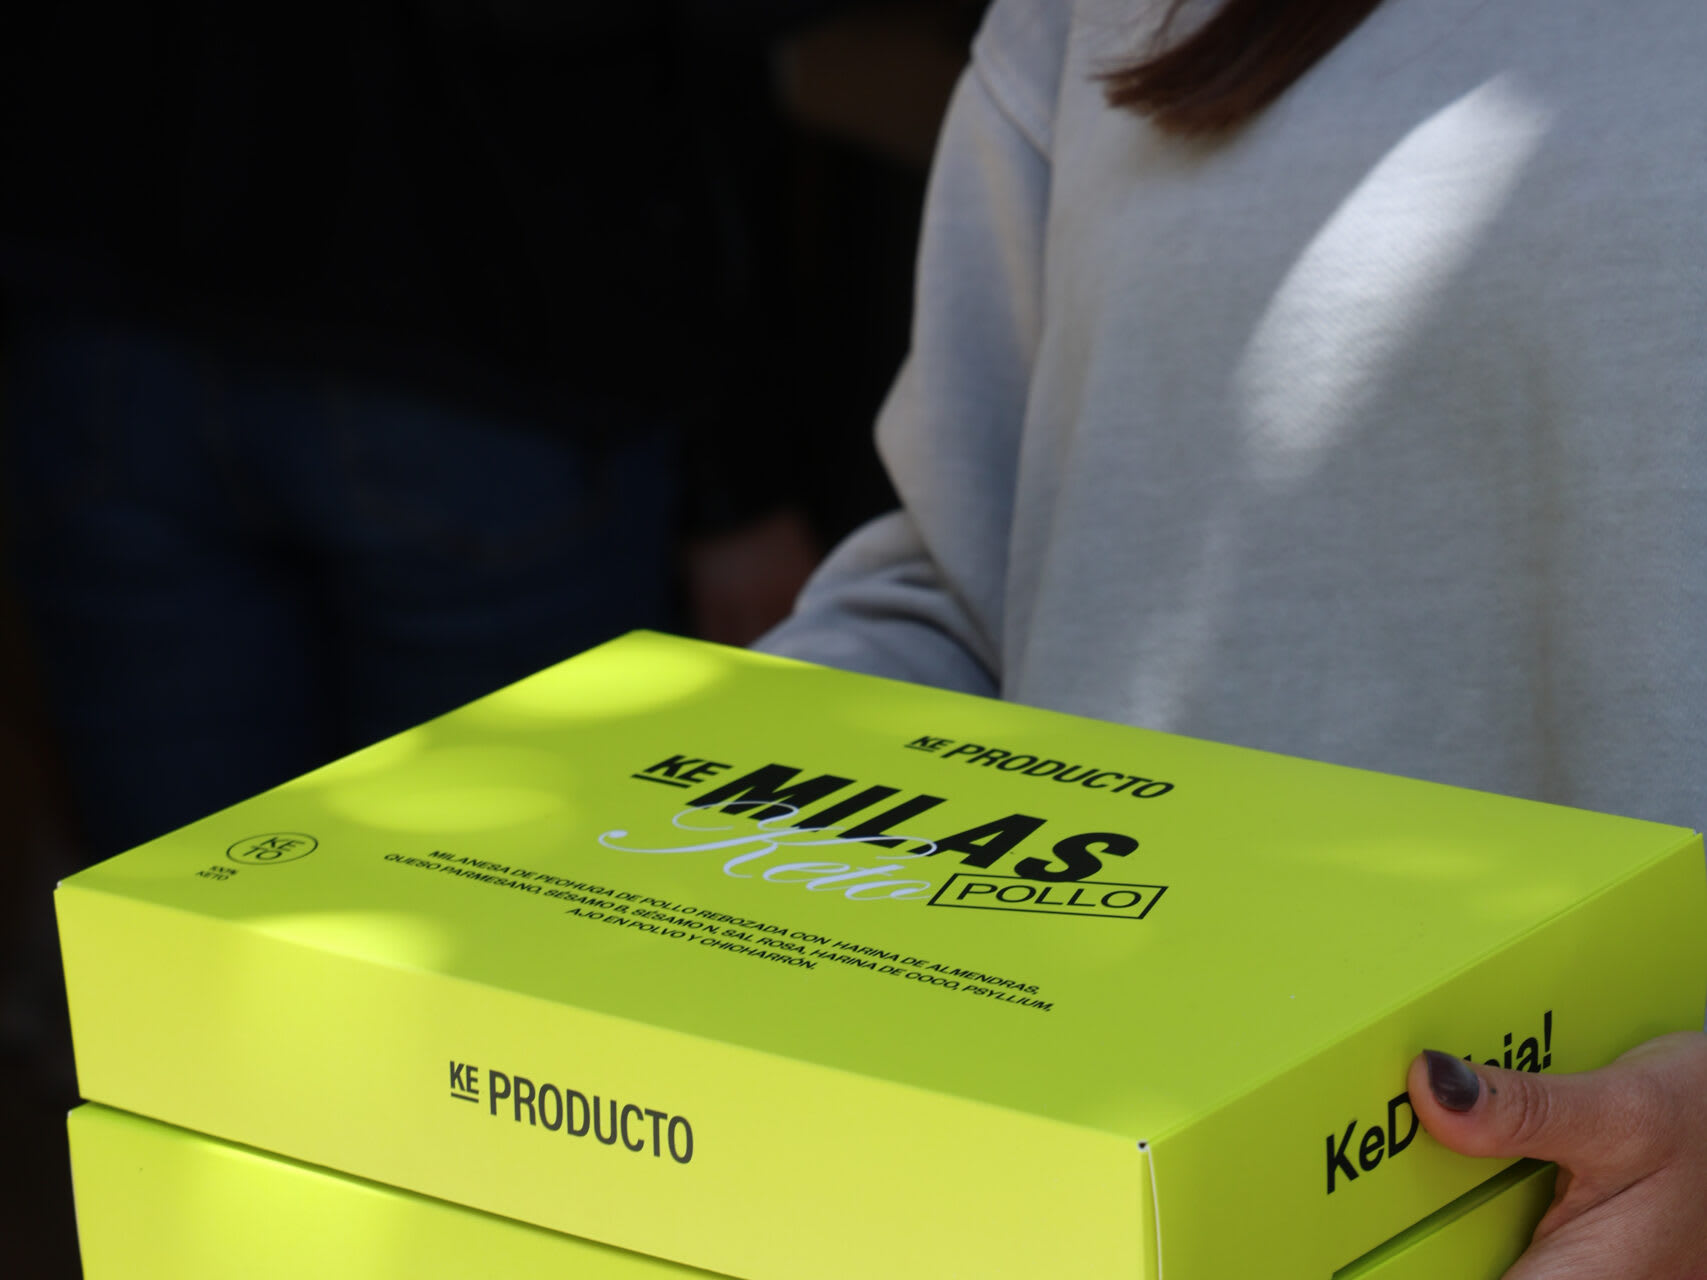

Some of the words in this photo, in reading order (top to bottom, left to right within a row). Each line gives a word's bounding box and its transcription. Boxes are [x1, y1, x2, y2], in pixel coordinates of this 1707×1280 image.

[636, 753, 734, 787] KE
[685, 763, 1139, 882] MILAS
[905, 735, 955, 752] KE
[940, 743, 1175, 798] PRODUCTO
[599, 801, 931, 900] Keto
[956, 882, 1142, 909] POLLO
[383, 853, 442, 870] QUESO
[721, 929, 754, 942] SAL
[756, 937, 806, 955] ROSA,
[809, 949, 877, 970] HARINA
[877, 965, 907, 977] DE
[904, 971, 960, 991] COCO,
[961, 984, 1055, 1012] PSYLLIUM,
[427, 850, 511, 874] MILANESA
[510, 868, 538, 880] DE
[534, 874, 615, 897] PECHUGA
[615, 891, 642, 903] DE
[639, 897, 698, 914] POLLO
[695, 909, 788, 936] REBOZADA
[789, 931, 831, 945] CON
[831, 940, 900, 962] HARINA
[900, 956, 930, 968] DE
[925, 963, 1040, 995] ALMENDRAS,
[564, 908, 605, 920] AJO
[602, 915, 631, 926] EN
[627, 921, 686, 938] POLVO
[687, 934, 703, 942] Y
[449, 1060, 480, 1098] KE
[488, 1069, 694, 1164] PRODUCTO
[1325, 1009, 1553, 1195] KeDia!
